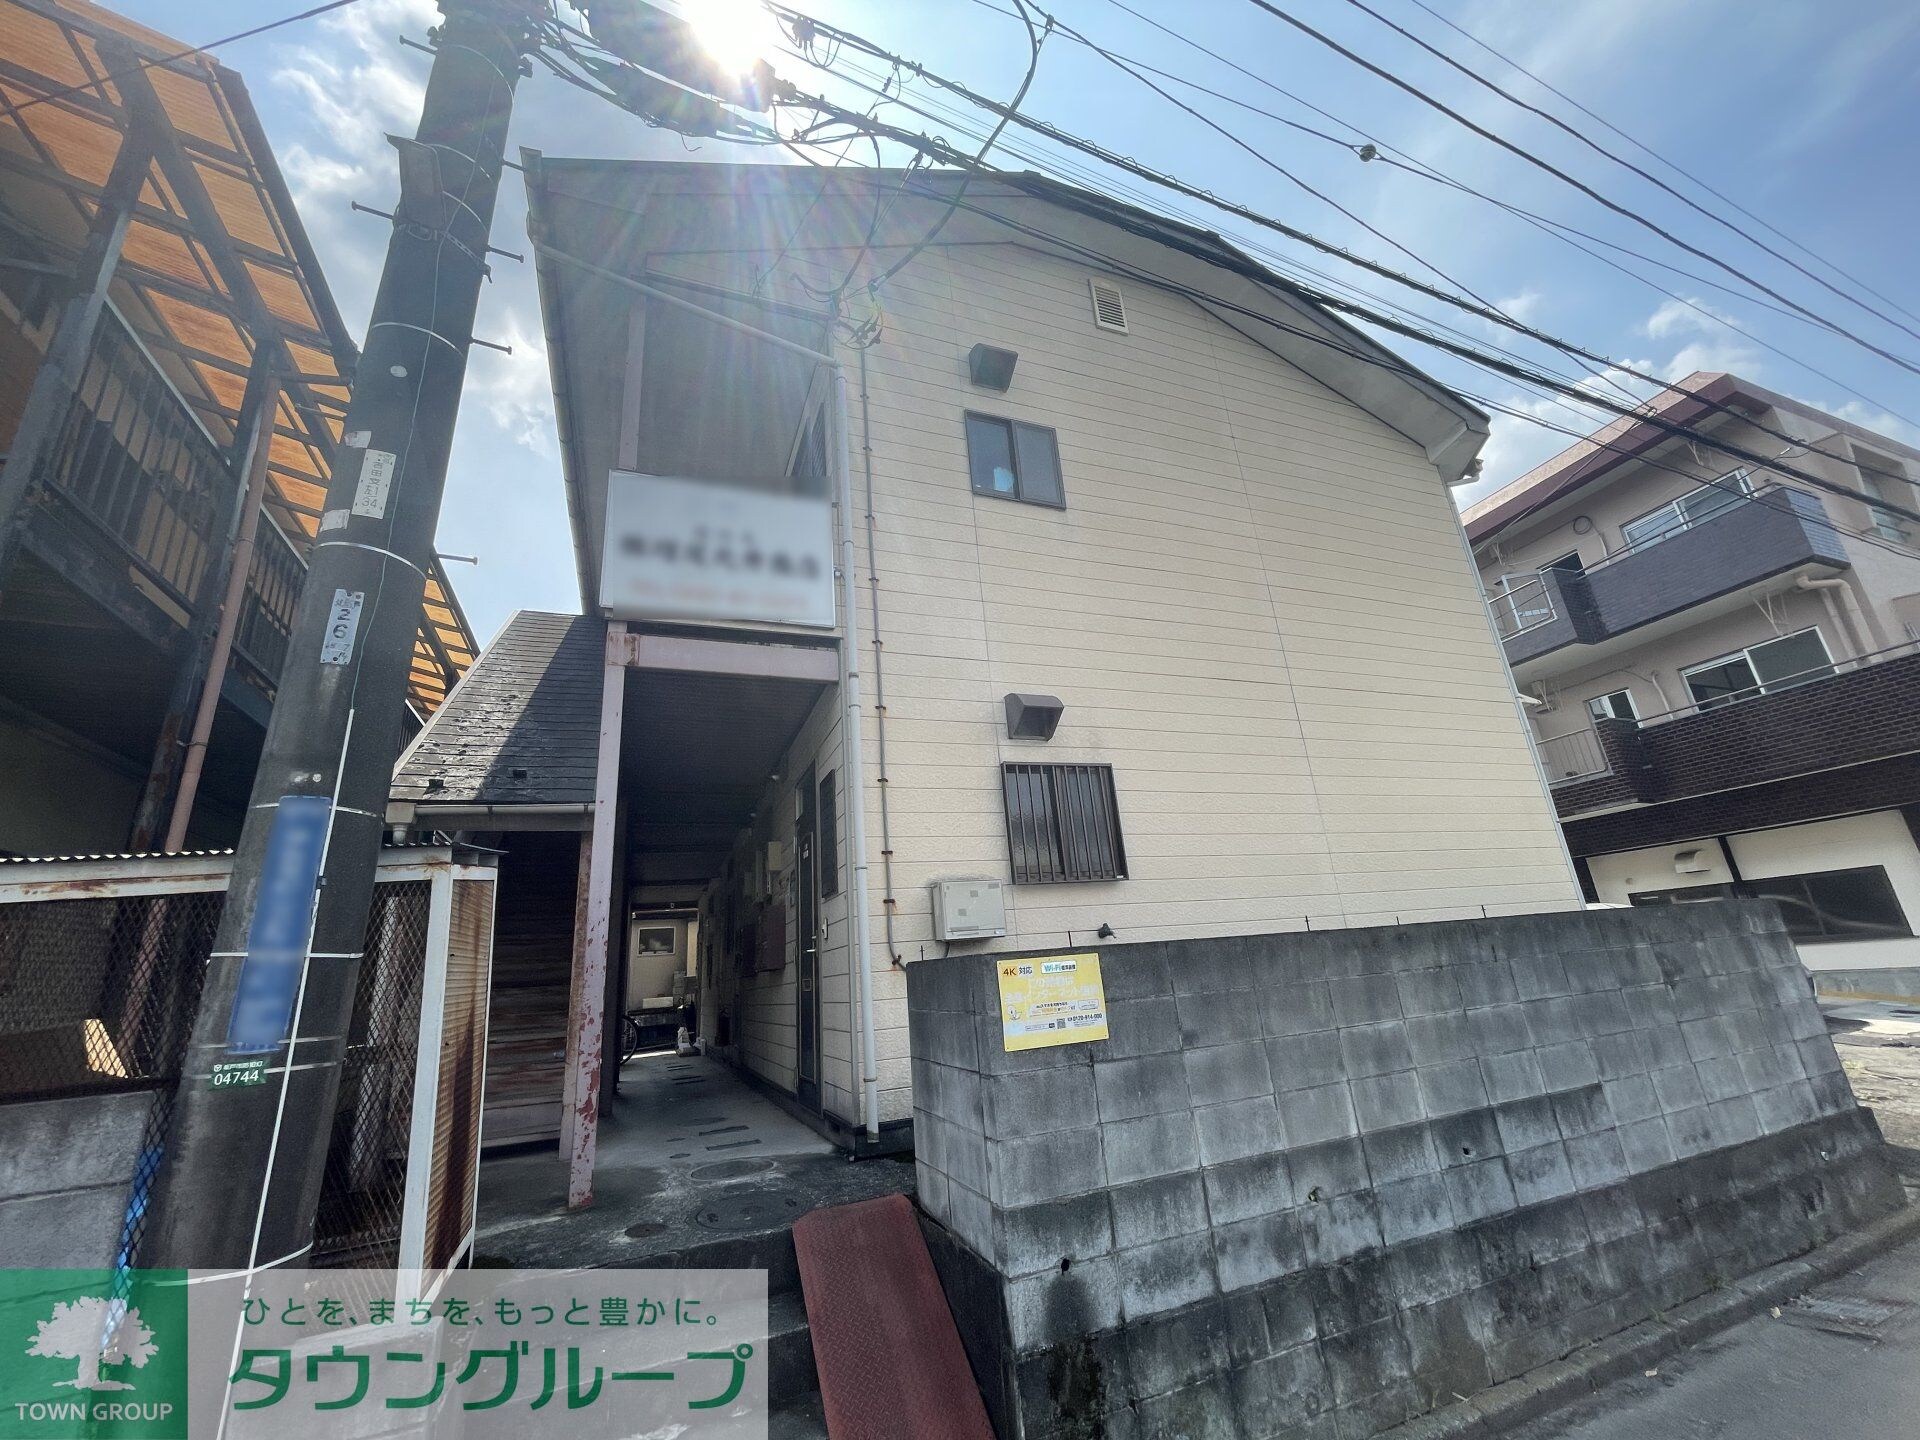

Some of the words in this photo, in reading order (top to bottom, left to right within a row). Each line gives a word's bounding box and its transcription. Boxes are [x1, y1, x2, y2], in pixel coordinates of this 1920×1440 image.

[1003, 968, 1017, 976] 4K
[1018, 966, 1032, 975] 対応
[214, 1070, 259, 1086] 04744
